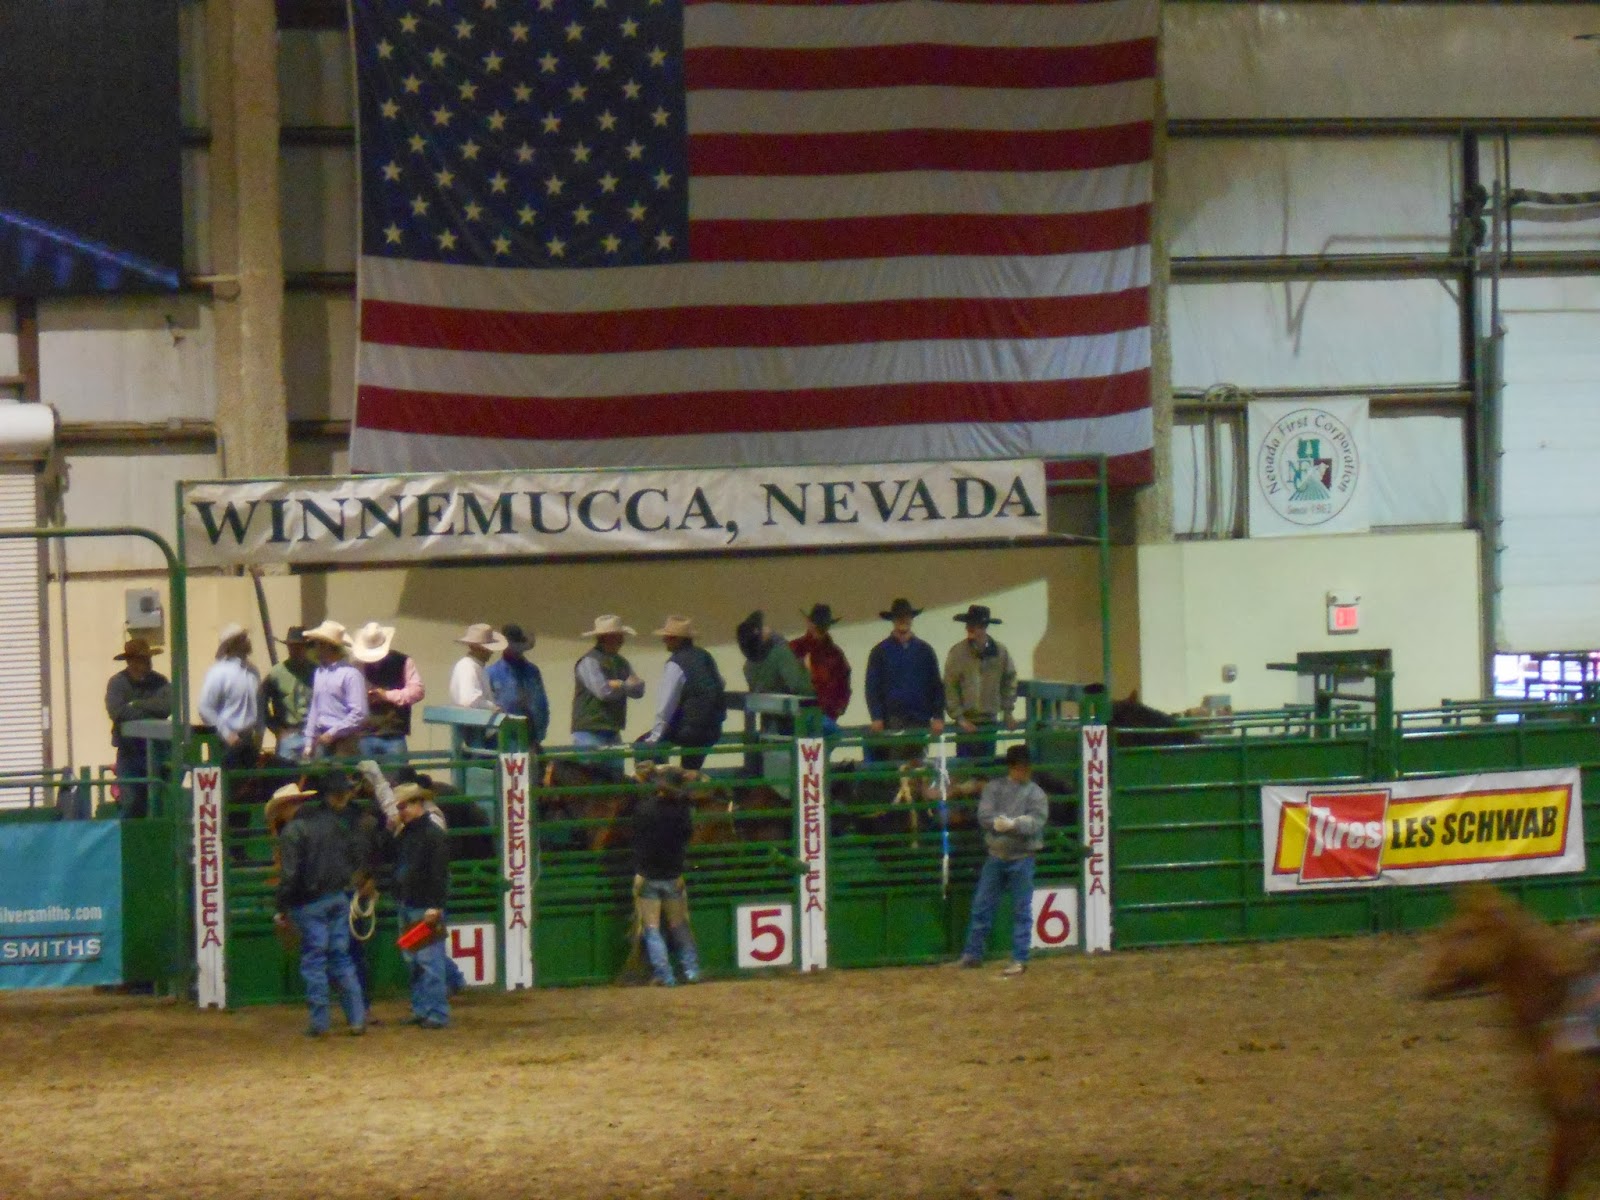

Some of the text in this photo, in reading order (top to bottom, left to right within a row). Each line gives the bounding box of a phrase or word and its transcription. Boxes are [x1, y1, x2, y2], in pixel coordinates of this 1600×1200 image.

[1265, 414, 1355, 496] Nevada First Corporation
[193, 476, 1041, 545] WINNEMUCCA, NEVADA
[504, 757, 527, 929] WINNEMUCCA
[1310, 806, 1382, 857] Tires
[1391, 805, 1558, 850] LES SCHWAB
[197, 772, 221, 949] WINNEMUCCA
[749, 908, 786, 962] 5
[1035, 892, 1070, 945] 6
[3, 938, 101, 959] SMITHS
[451, 928, 484, 982] 4
